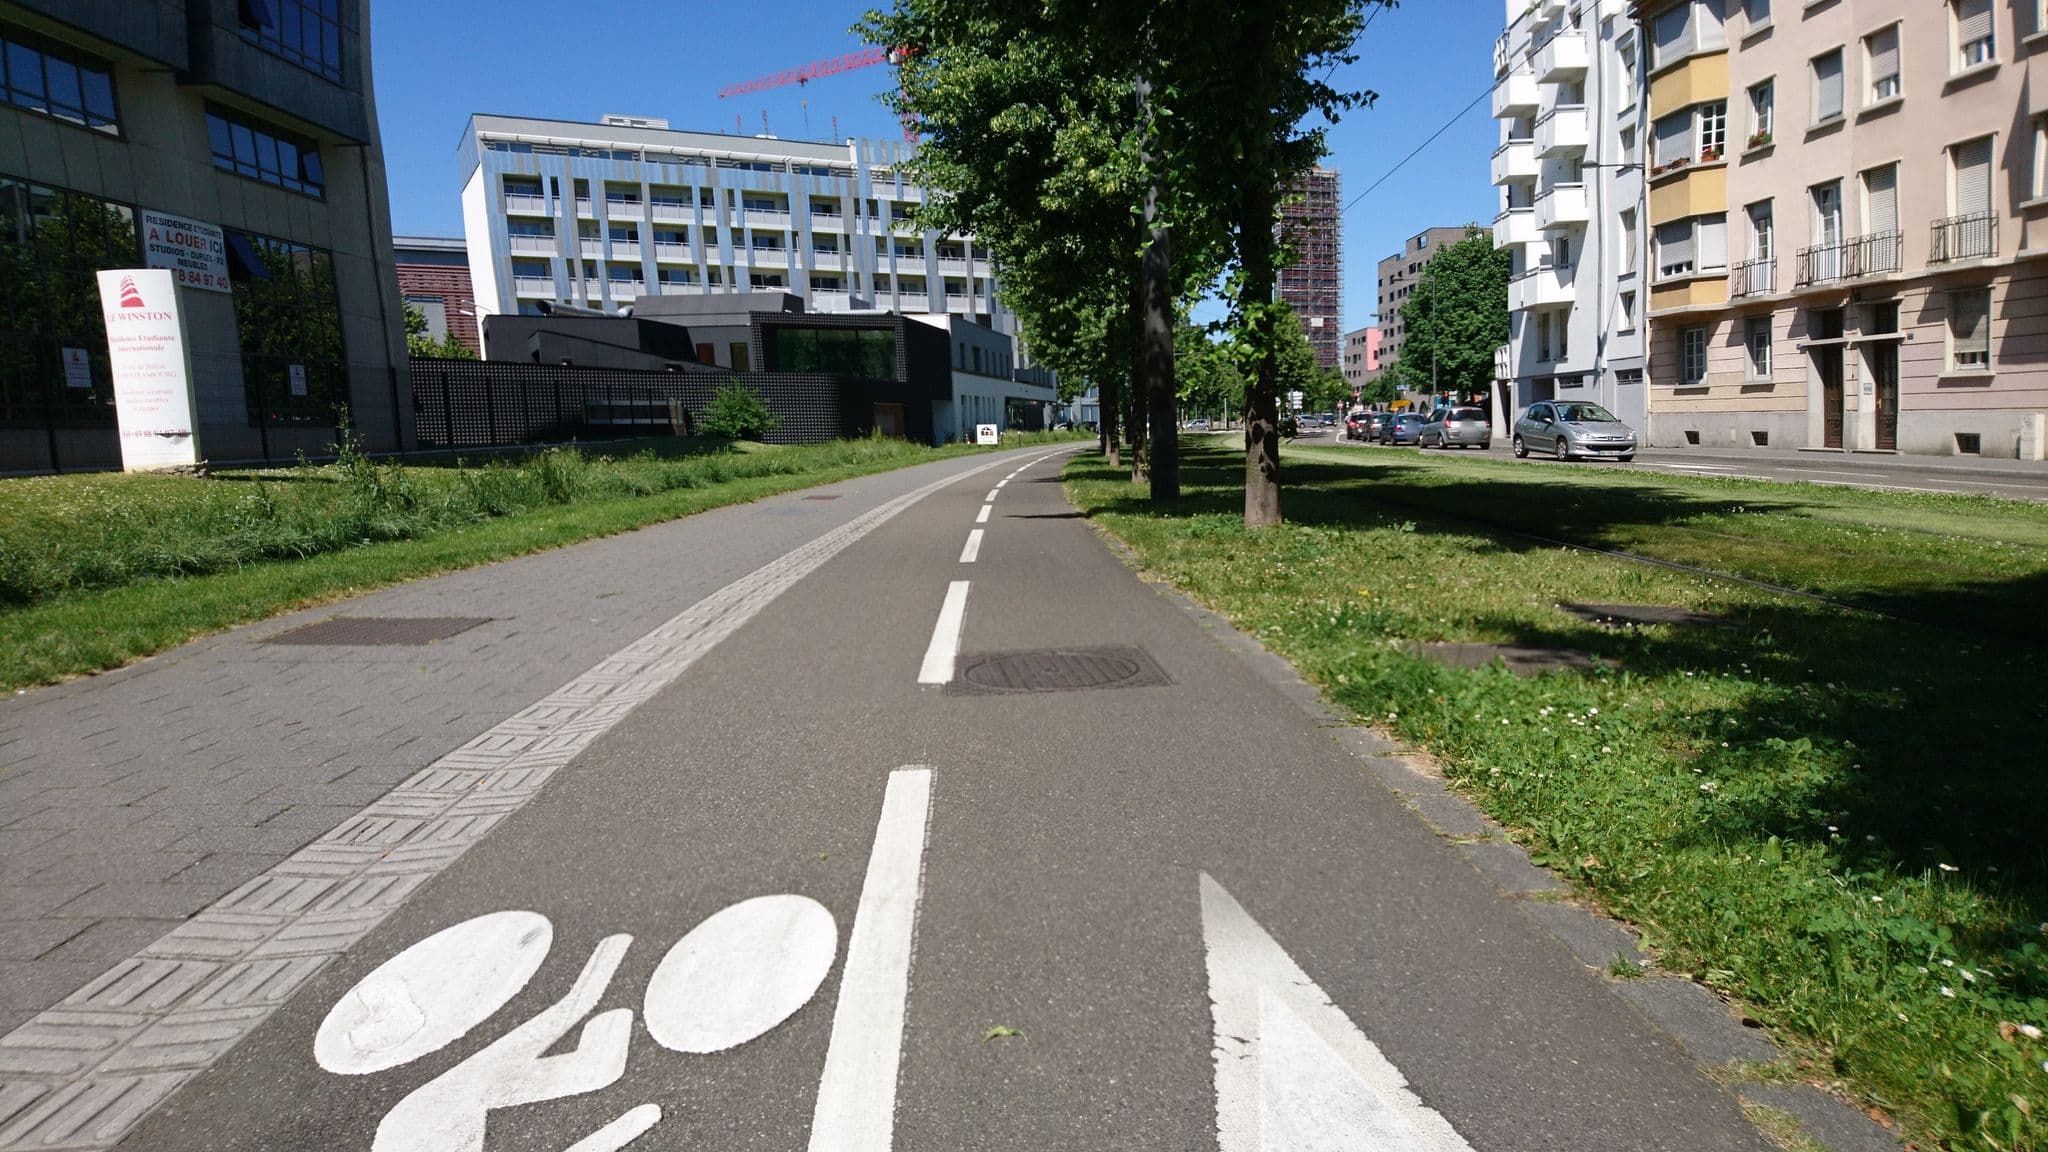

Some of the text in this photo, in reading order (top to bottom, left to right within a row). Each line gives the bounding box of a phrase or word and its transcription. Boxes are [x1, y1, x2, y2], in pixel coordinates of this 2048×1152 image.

[146, 215, 192, 232] RESIDENCE
[149, 227, 223, 254] A LOUER ICI
[149, 243, 185, 257] STUDIOS
[188, 270, 201, 284] 84
[203, 274, 214, 287] 97
[217, 276, 229, 289] 40
[118, 311, 174, 321] WINSTON
